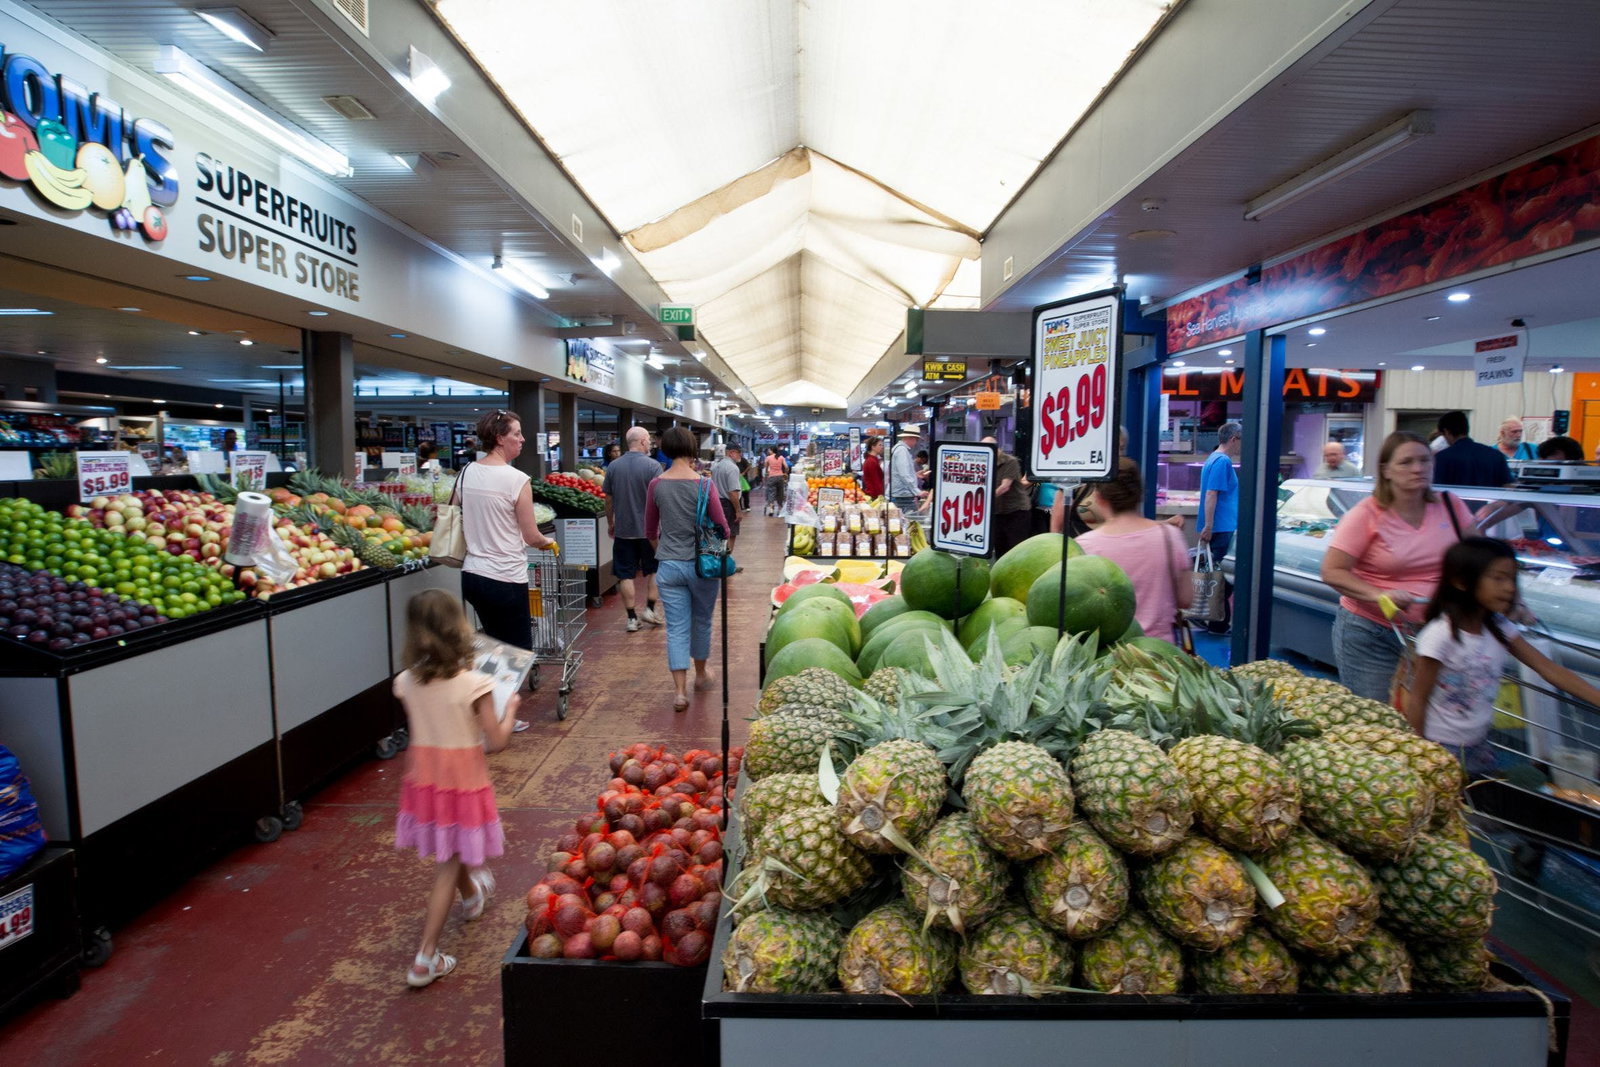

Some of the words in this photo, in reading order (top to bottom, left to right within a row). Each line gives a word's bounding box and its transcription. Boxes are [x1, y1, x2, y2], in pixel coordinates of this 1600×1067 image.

[0, 43, 179, 208] OM'S
[195, 152, 357, 255] SUPERFRUITS
[197, 213, 288, 279] SUPER
[294, 251, 360, 302] STORE
[663, 309, 684, 321] EXIT
[1073, 309, 1109, 321] SUPERFRUITS
[1073, 321, 1090, 330] SUPER
[1091, 317, 1109, 326] STORE
[1186, 322, 1201, 337] Sea
[1201, 311, 1232, 333] Harvest
[1044, 333, 1076, 353] SWEET
[1078, 326, 1108, 348] JUICY
[925, 362, 944, 372] KWIK
[946, 363, 966, 372] CASH
[1043, 345, 1108, 370] PINEAPPLES
[1479, 368, 1514, 381] PRAWNS
[1041, 364, 1106, 460] $3.99
[1090, 450, 1104, 464] EA
[943, 462, 987, 475] SEEDLESS
[83, 471, 129, 495] $5.99
[942, 472, 986, 486] WATERMELON
[941, 486, 985, 539] $1.99
[965, 532, 984, 543] KG
